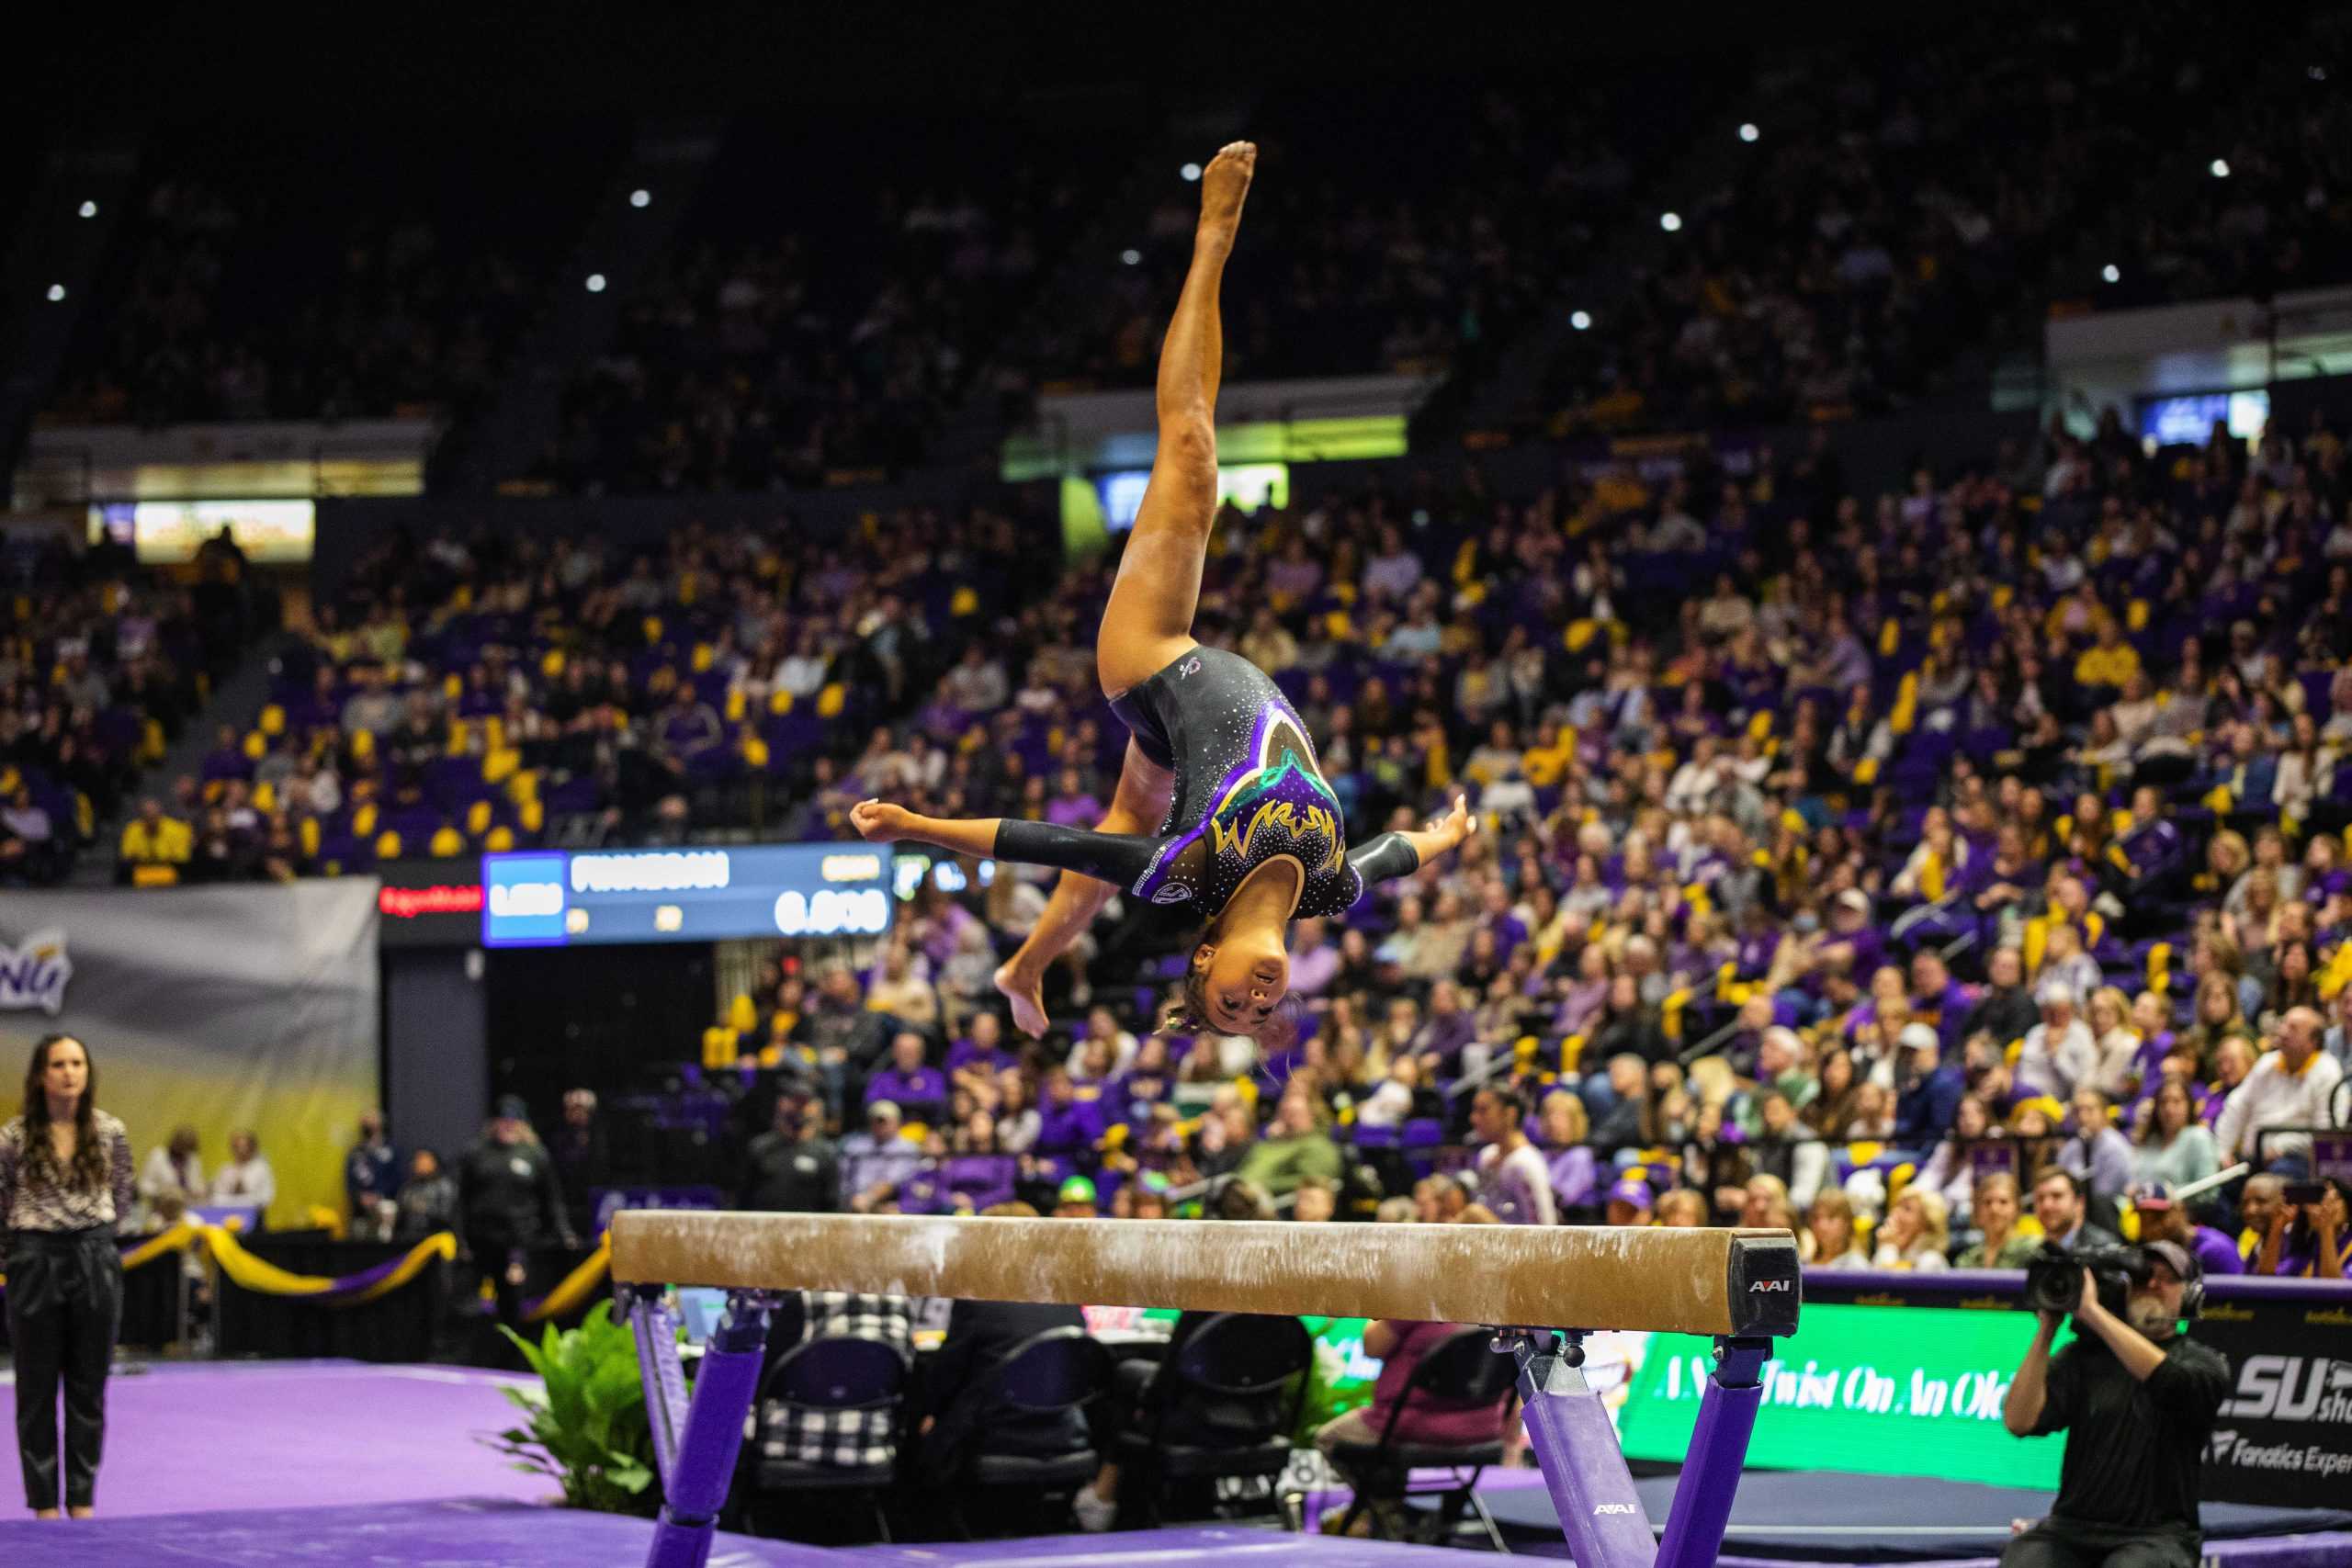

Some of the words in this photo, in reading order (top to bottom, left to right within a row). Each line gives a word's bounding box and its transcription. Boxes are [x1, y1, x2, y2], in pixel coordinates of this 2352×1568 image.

[1842, 1366, 1895, 1414] On
[1894, 1367, 1949, 1417] An
[2217, 1355, 2330, 1419] SU
[2231, 1438, 2304, 1470] Fanatics
